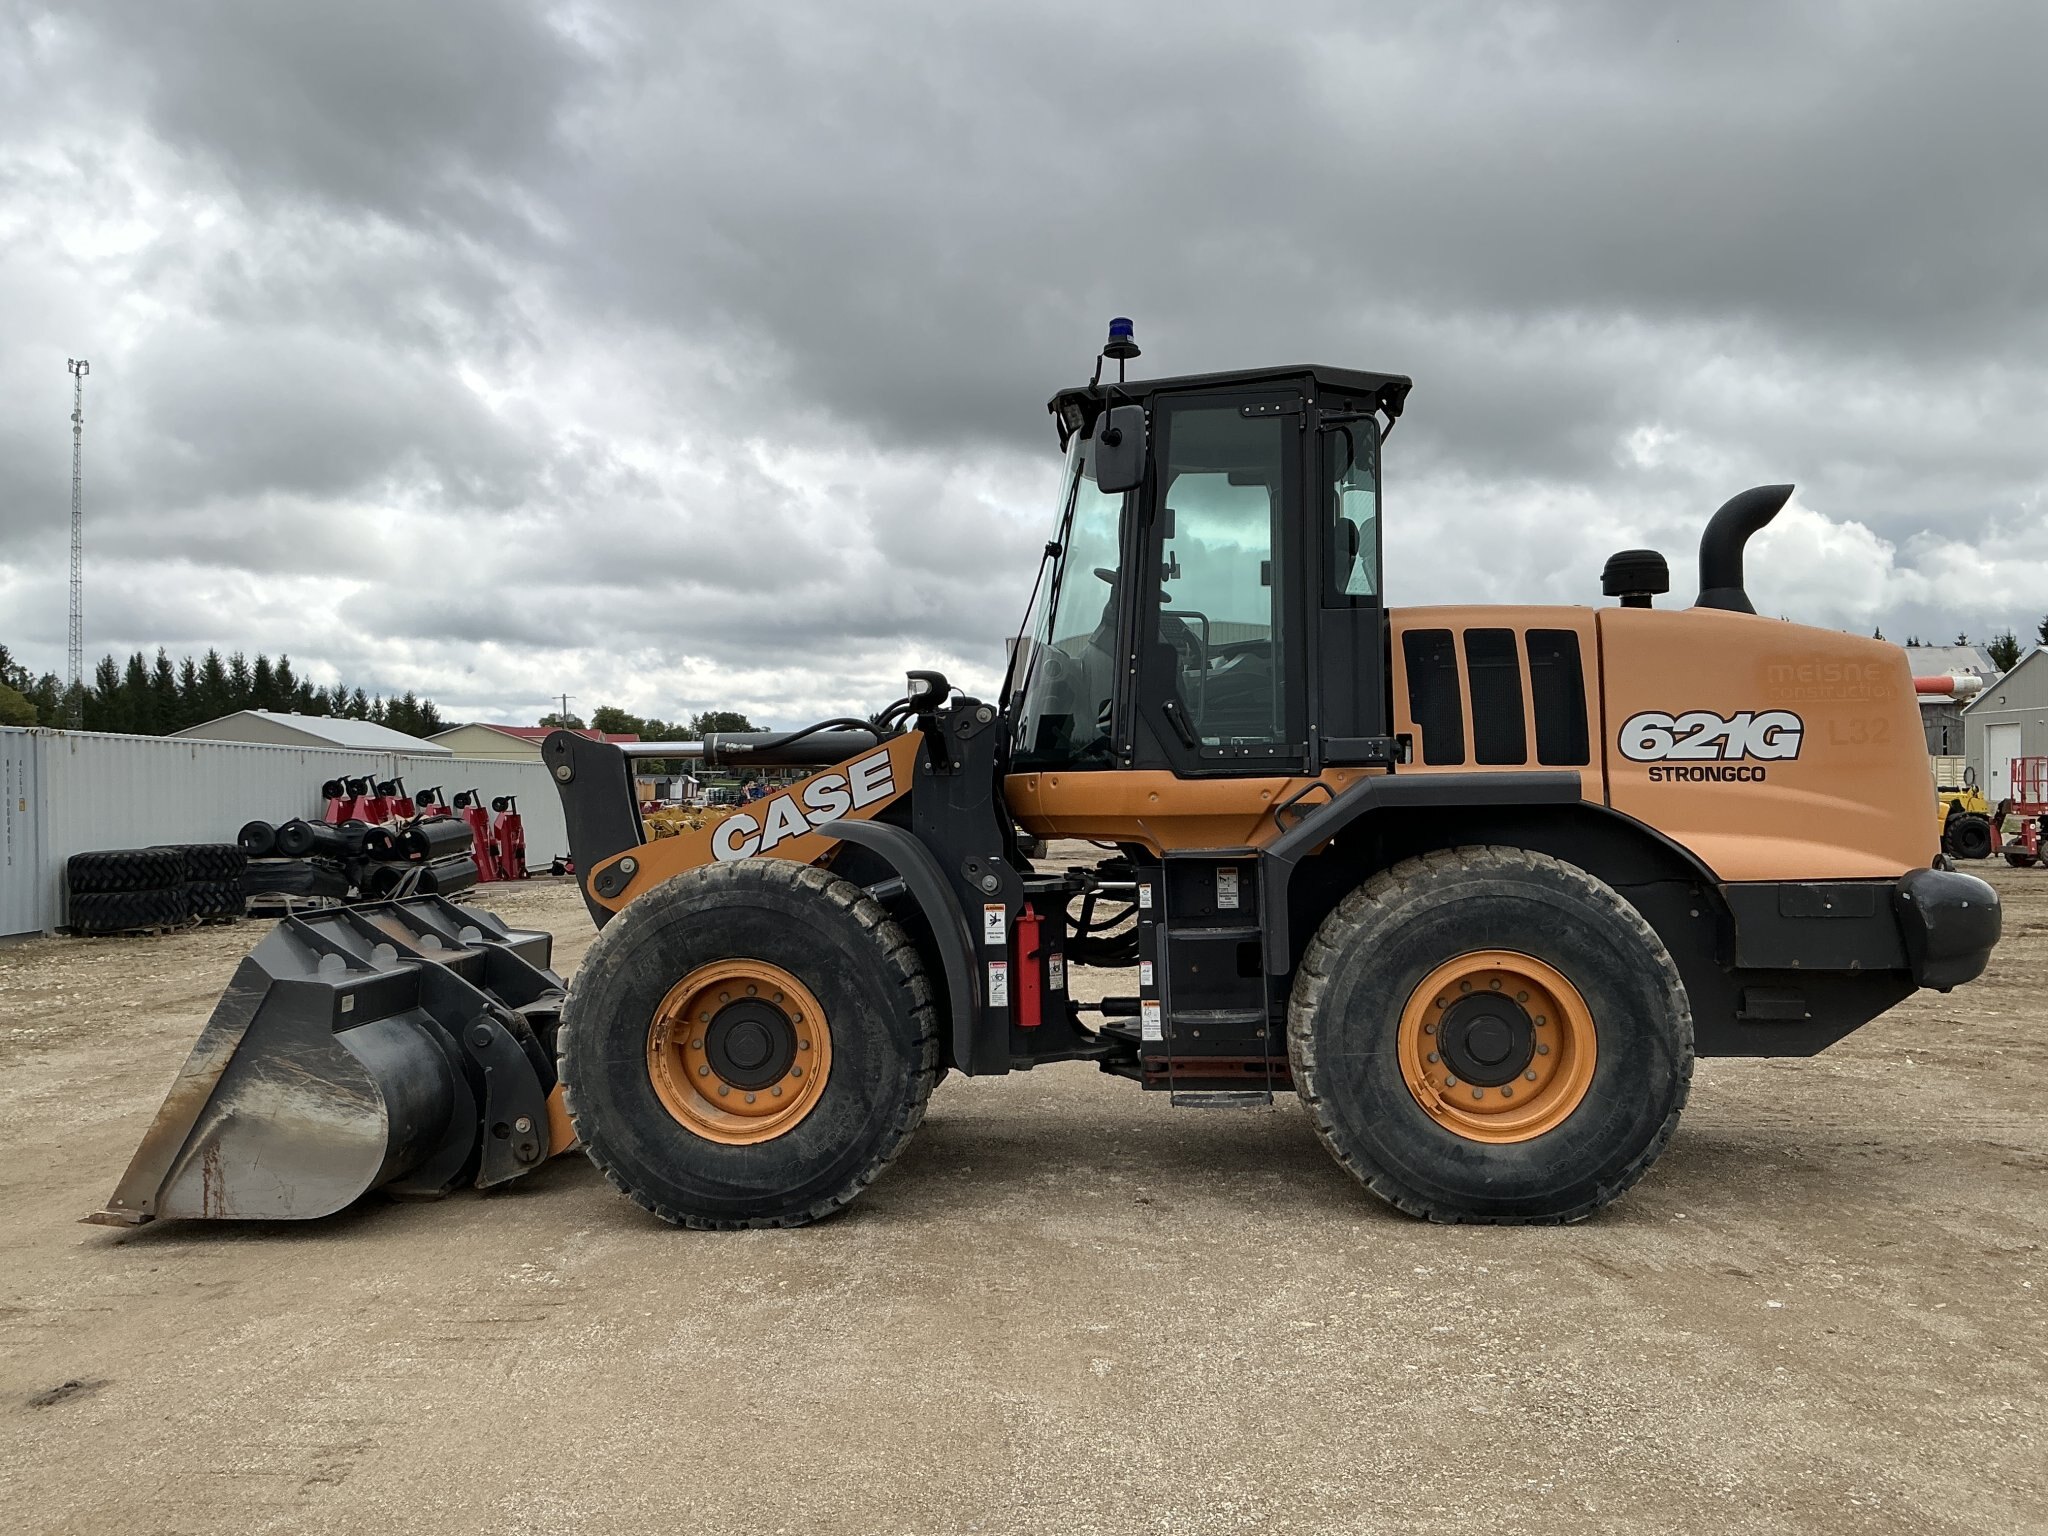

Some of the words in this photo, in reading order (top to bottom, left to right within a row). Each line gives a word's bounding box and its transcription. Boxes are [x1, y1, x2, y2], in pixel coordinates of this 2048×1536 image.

[1617, 710, 1804, 762] 621G
[1828, 717, 1892, 746] L32
[1648, 766, 1766, 782] STRONGCO
[711, 748, 896, 861] CASE
